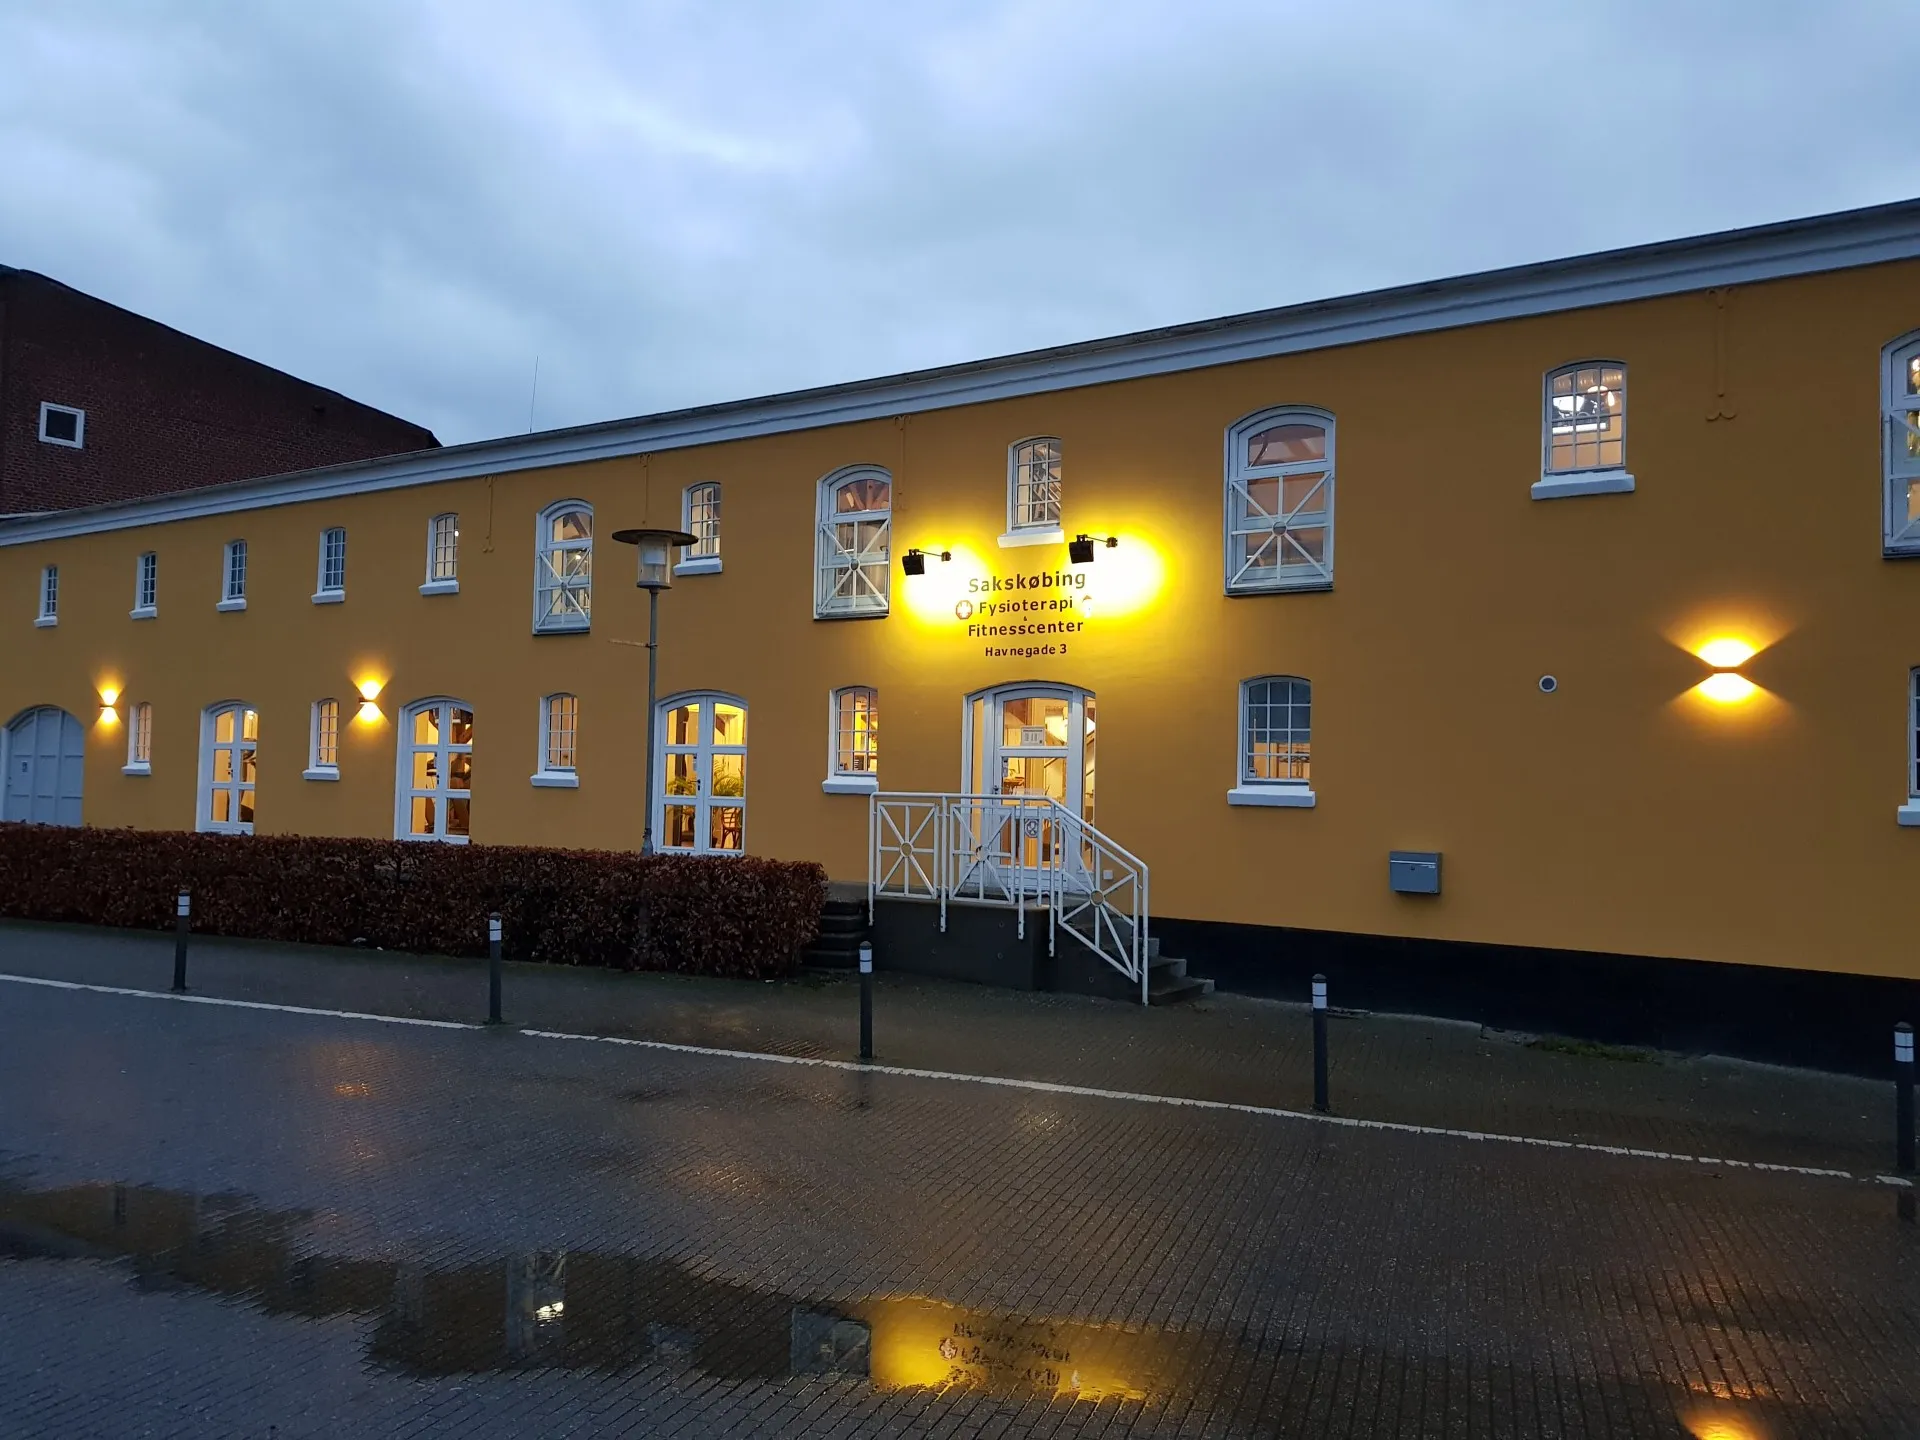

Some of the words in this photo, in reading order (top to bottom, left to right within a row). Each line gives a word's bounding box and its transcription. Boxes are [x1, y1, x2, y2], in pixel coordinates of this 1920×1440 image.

[968, 571, 1086, 593] Sakskøbing
[979, 596, 1073, 616] Fysioterapi
[968, 620, 1084, 637] Fitnesscenter
[985, 644, 1056, 658] Havnegade
[1060, 643, 1067, 654] 3
